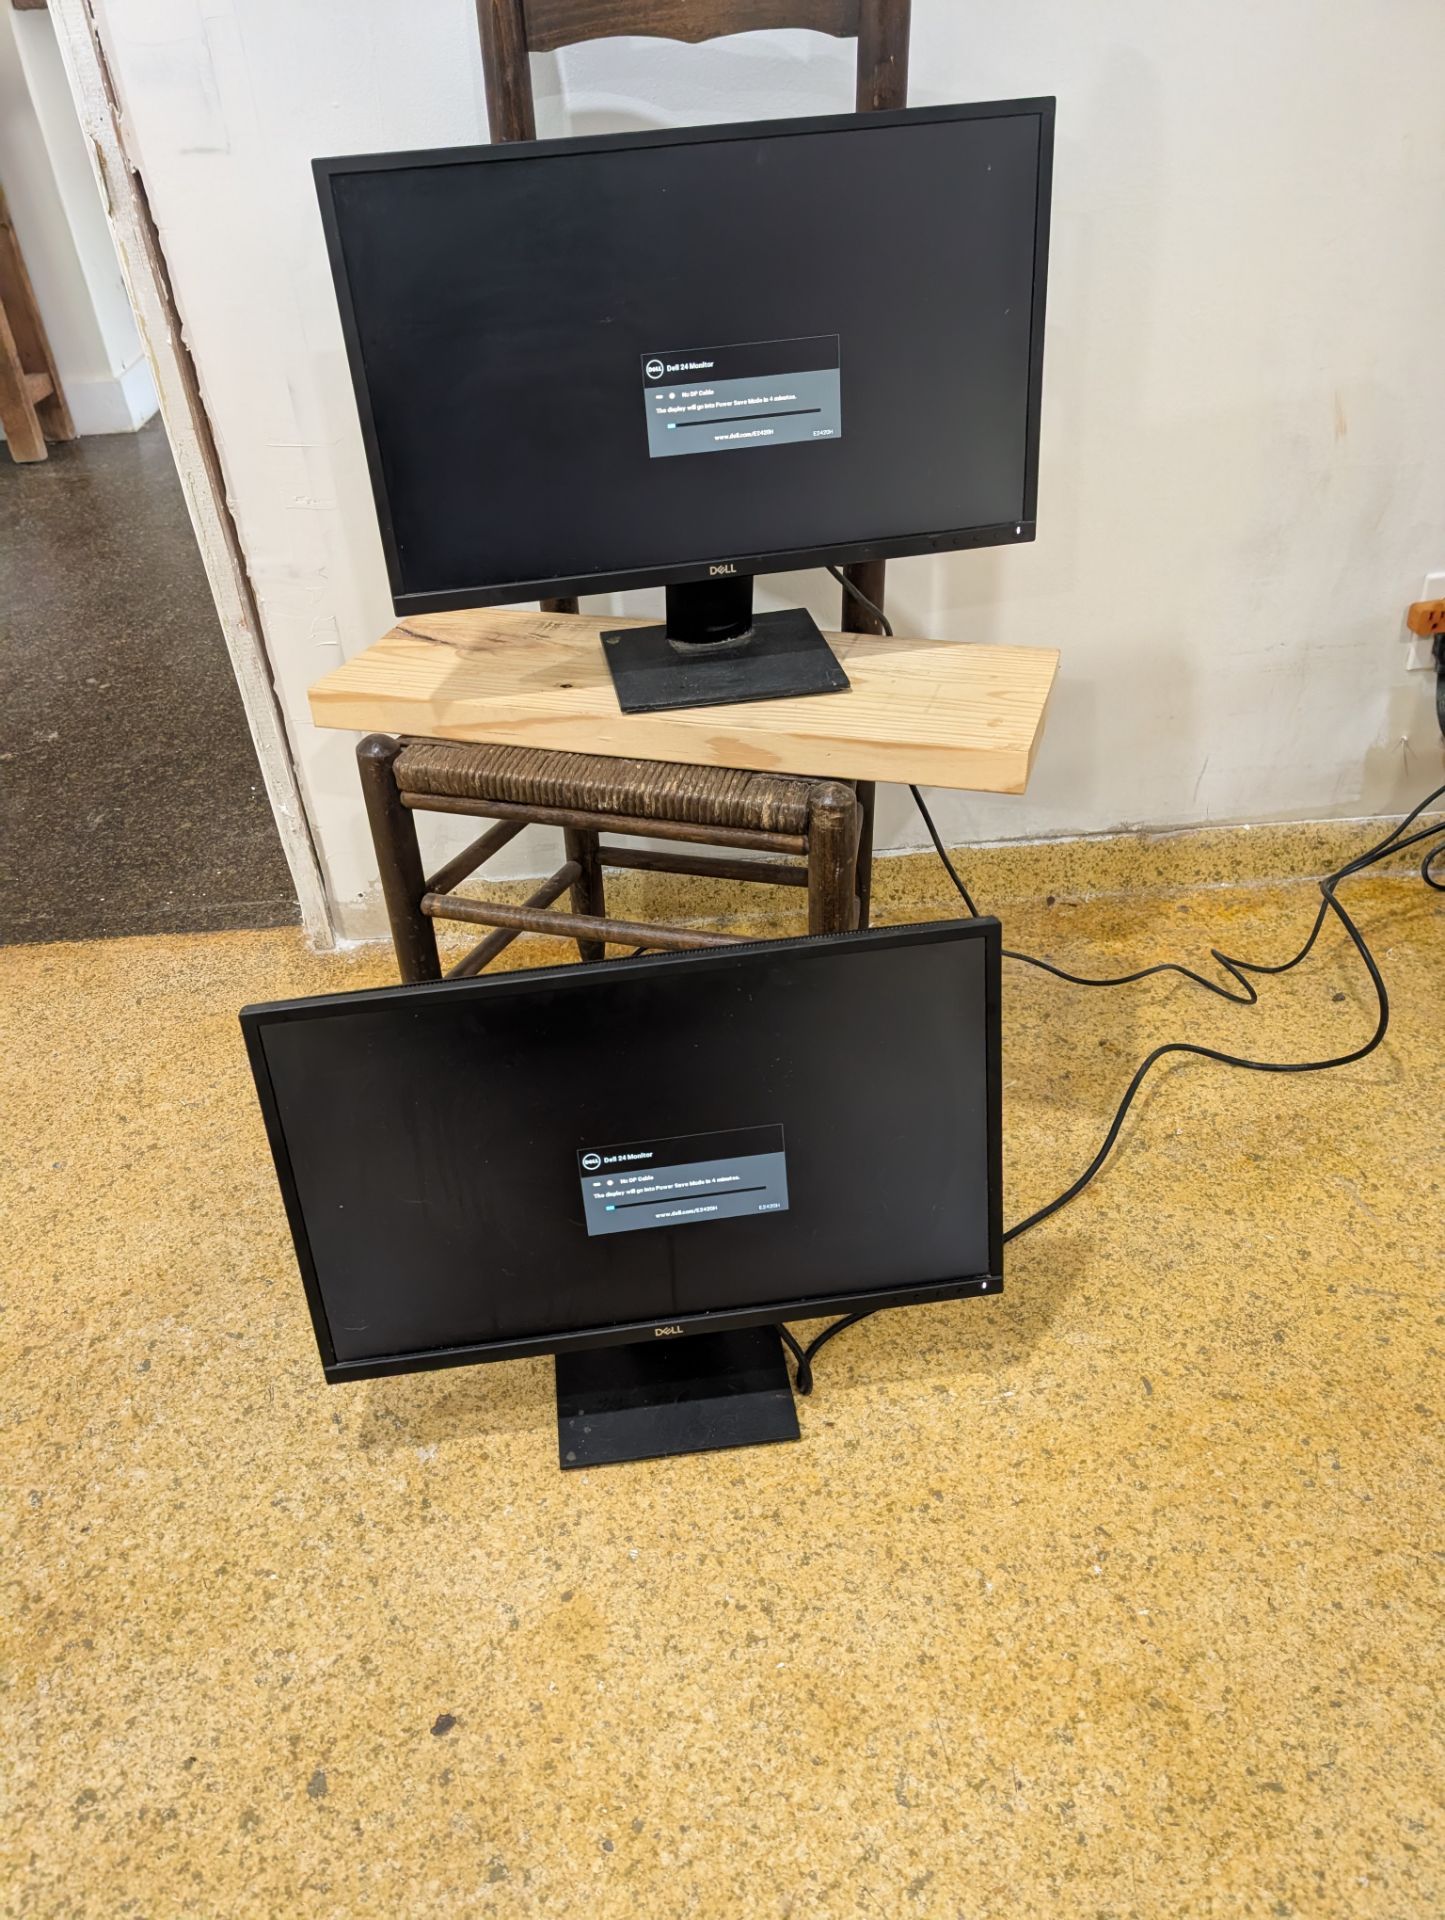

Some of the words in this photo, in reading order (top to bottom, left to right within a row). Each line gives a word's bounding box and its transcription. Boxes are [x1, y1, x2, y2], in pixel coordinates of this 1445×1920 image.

[667, 364, 680, 372] Dell
[689, 361, 714, 370] Monitor
[667, 405, 686, 413] display
[709, 563, 737, 576] DELL
[603, 1156, 617, 1164] Dell
[627, 1152, 653, 1160] Monitor
[637, 1174, 654, 1182] Cable
[605, 1190, 625, 1198] display
[689, 1179, 705, 1187] Mode
[655, 1325, 684, 1337] DELL
